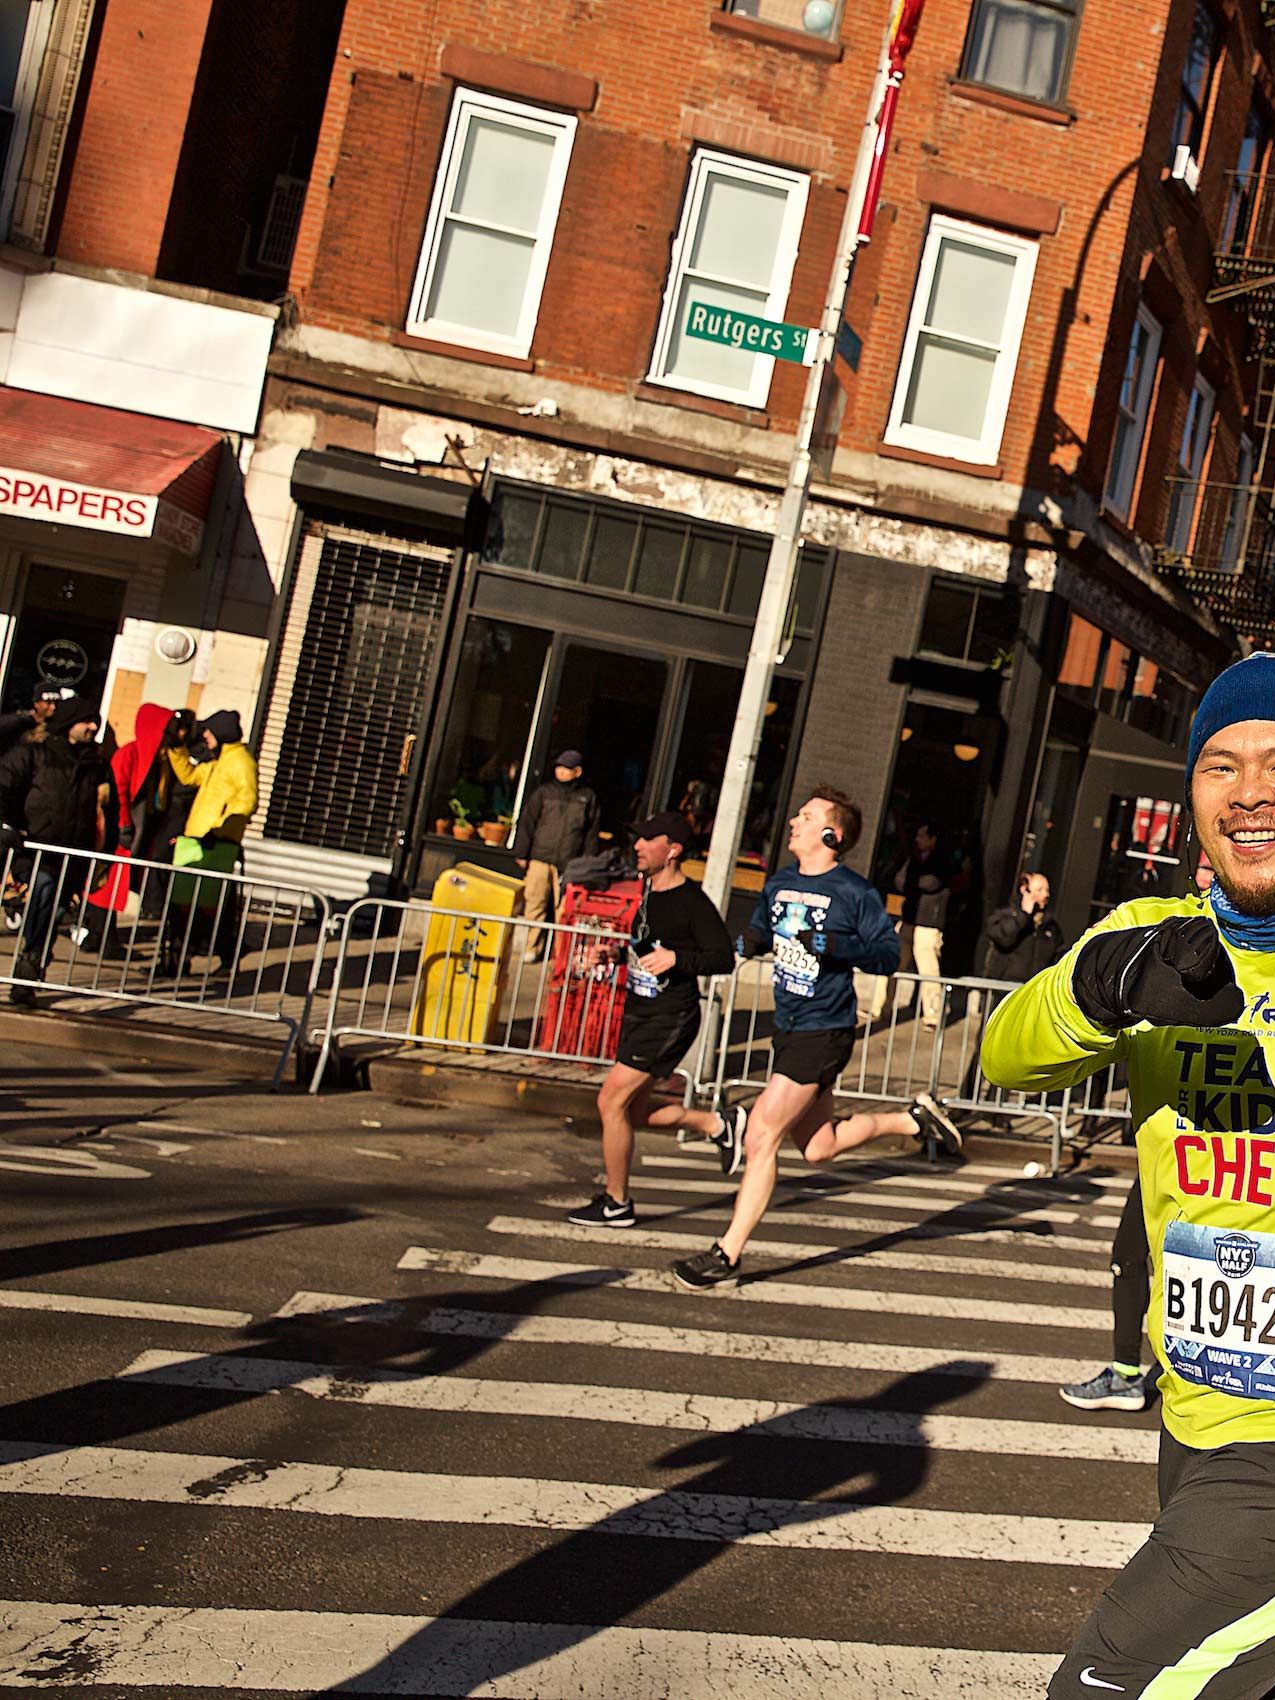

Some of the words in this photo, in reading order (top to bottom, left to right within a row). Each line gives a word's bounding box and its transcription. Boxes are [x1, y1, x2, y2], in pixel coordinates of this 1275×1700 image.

[691, 306, 784, 350] Rutgers
[1176, 1089, 1189, 1130] FOR
[1220, 1246, 1251, 1263] NYC
[1221, 1260, 1248, 1271] HALF
[1207, 1350, 1242, 1368] WAVE
[1243, 1356, 1252, 1369] 2
